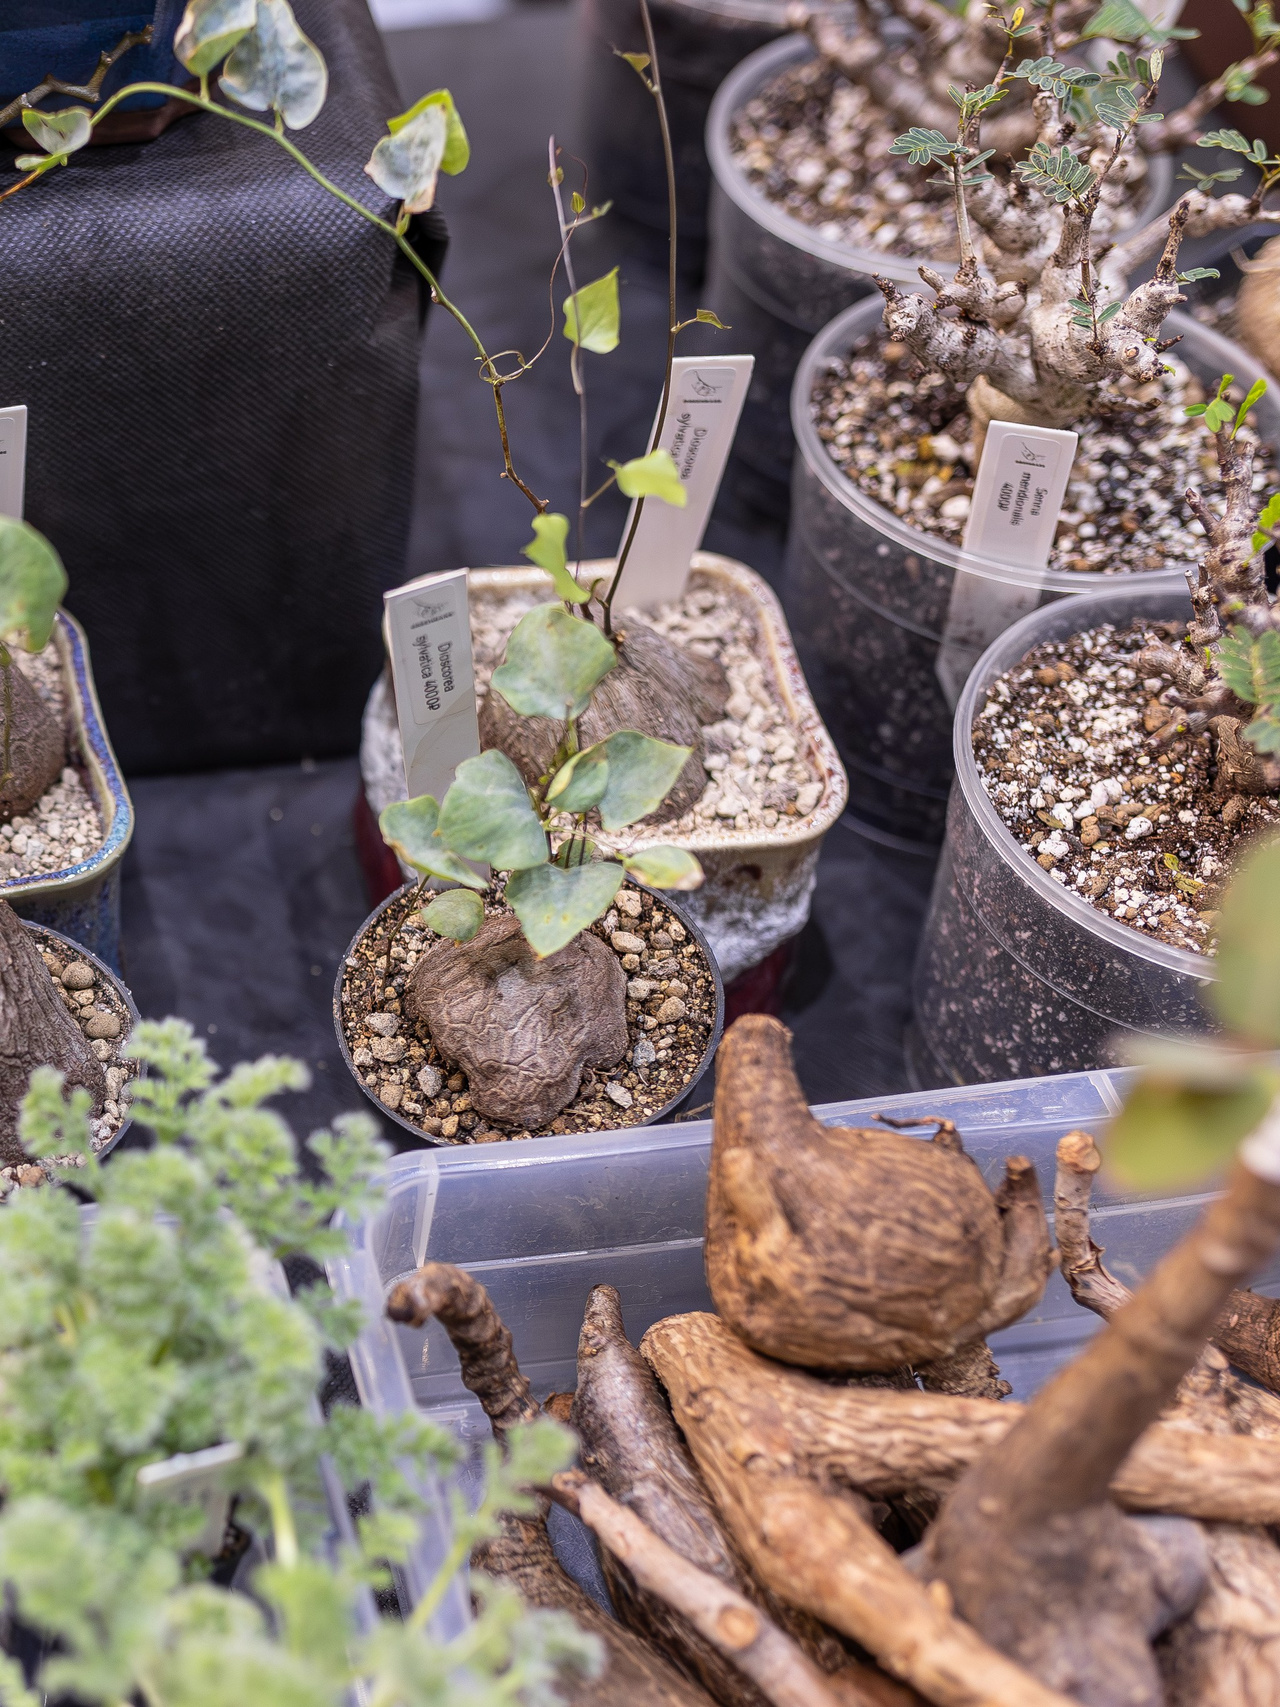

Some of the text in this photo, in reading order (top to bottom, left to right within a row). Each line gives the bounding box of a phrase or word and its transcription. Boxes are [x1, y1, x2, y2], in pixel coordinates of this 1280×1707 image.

[681, 427, 708, 480] Dioscorea
[1010, 472, 1031, 526] meridionalis
[1030, 487, 1048, 516] Senna
[412, 634, 432, 679] sylvatica
[438, 640, 454, 692] Dioscorea
